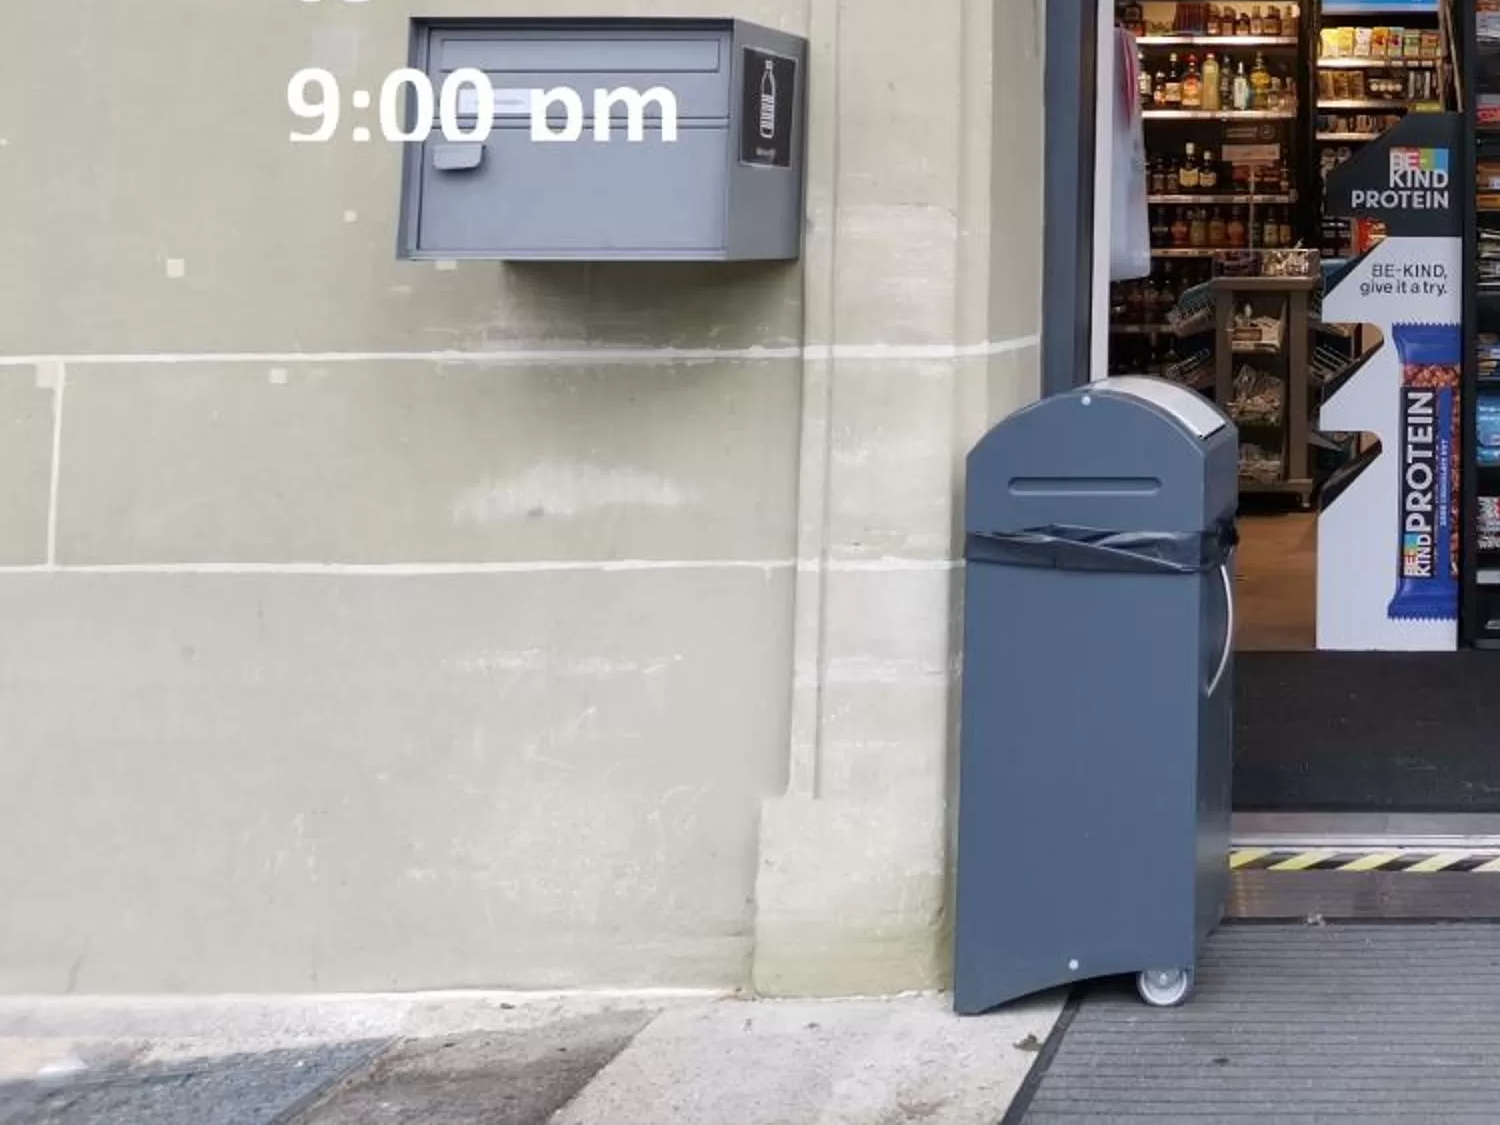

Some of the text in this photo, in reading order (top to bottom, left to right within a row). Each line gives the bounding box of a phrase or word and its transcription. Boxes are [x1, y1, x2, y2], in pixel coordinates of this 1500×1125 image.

[1390, 170, 1450, 188] KIND
[1351, 191, 1450, 209] PROTEIN
[1371, 264, 1448, 279] BE-KIND,
[1360, 280, 1448, 296] give it a try.
[1405, 391, 1433, 533] PROTEIN
[1416, 534, 1433, 576] KIND
